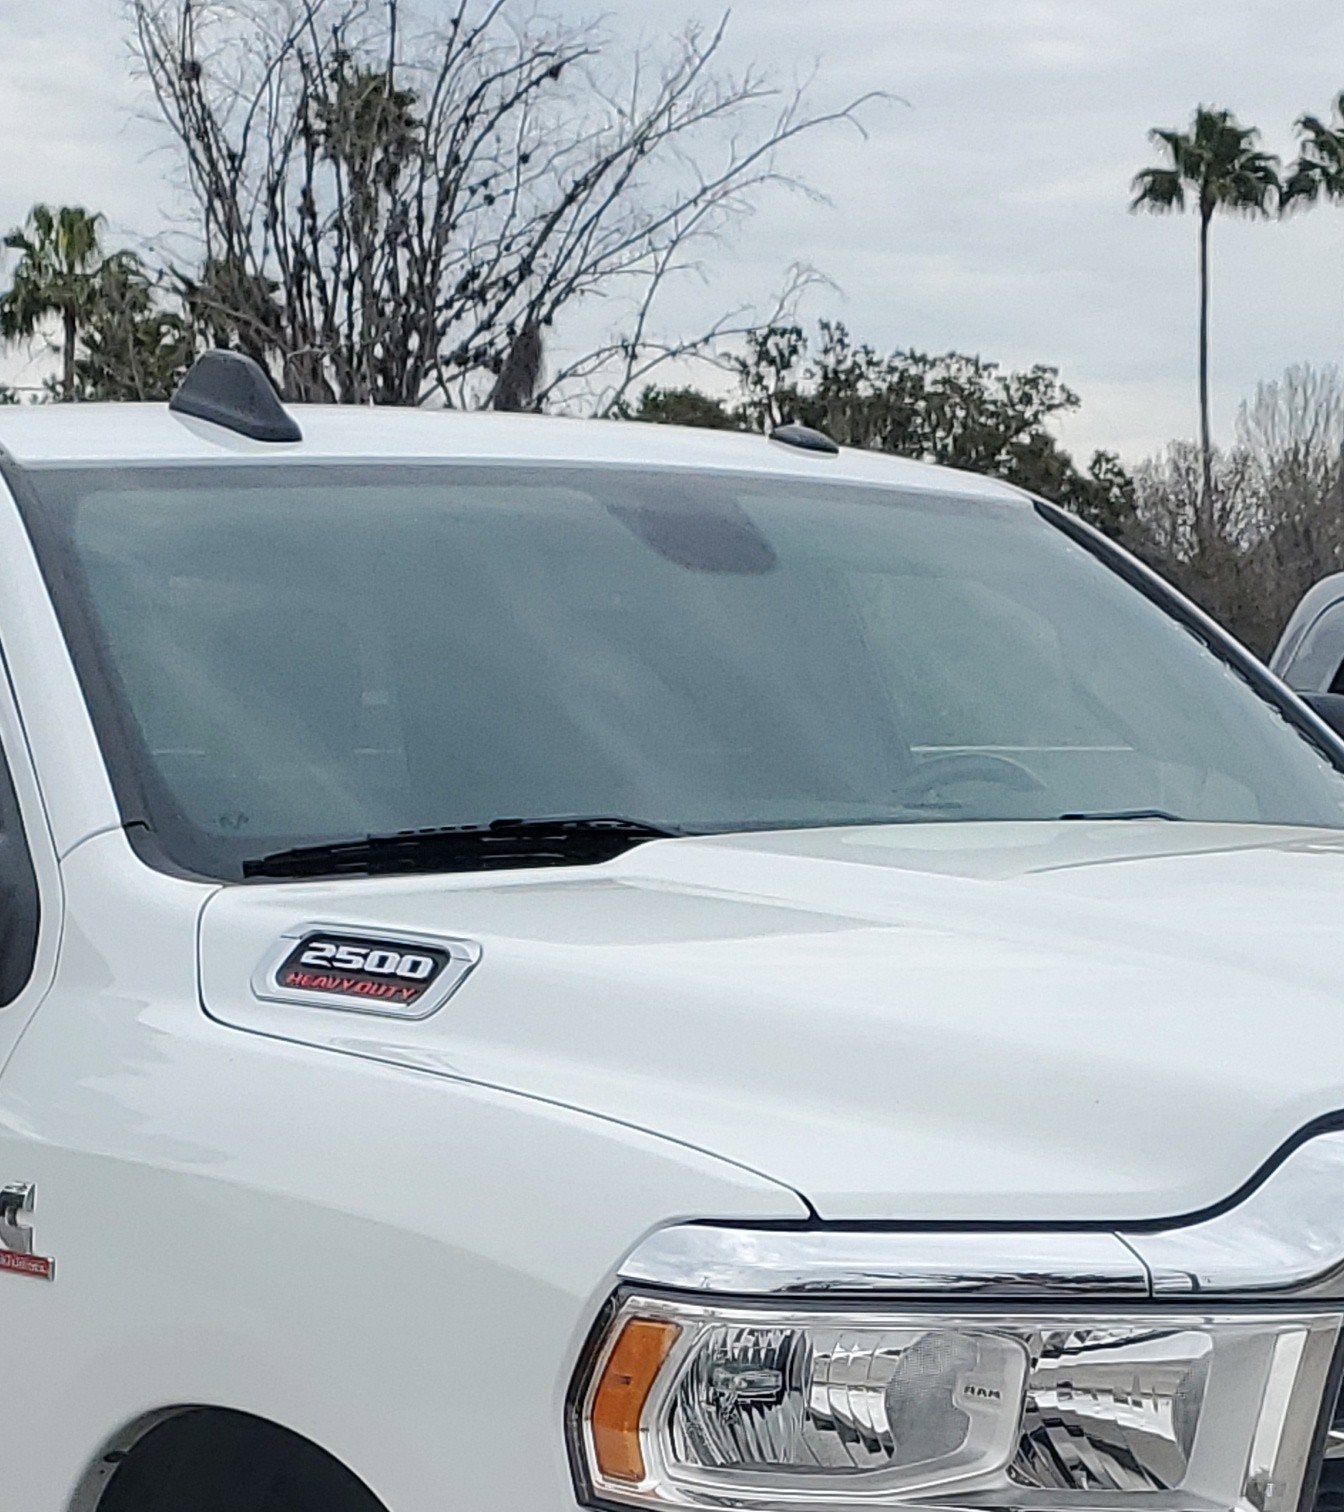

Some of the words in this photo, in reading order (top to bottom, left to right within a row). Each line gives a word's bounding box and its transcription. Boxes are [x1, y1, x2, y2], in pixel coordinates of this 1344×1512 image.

[300, 941, 433, 979] 2500
[286, 972, 354, 992] HEAVY
[355, 981, 418, 999] DUTY
